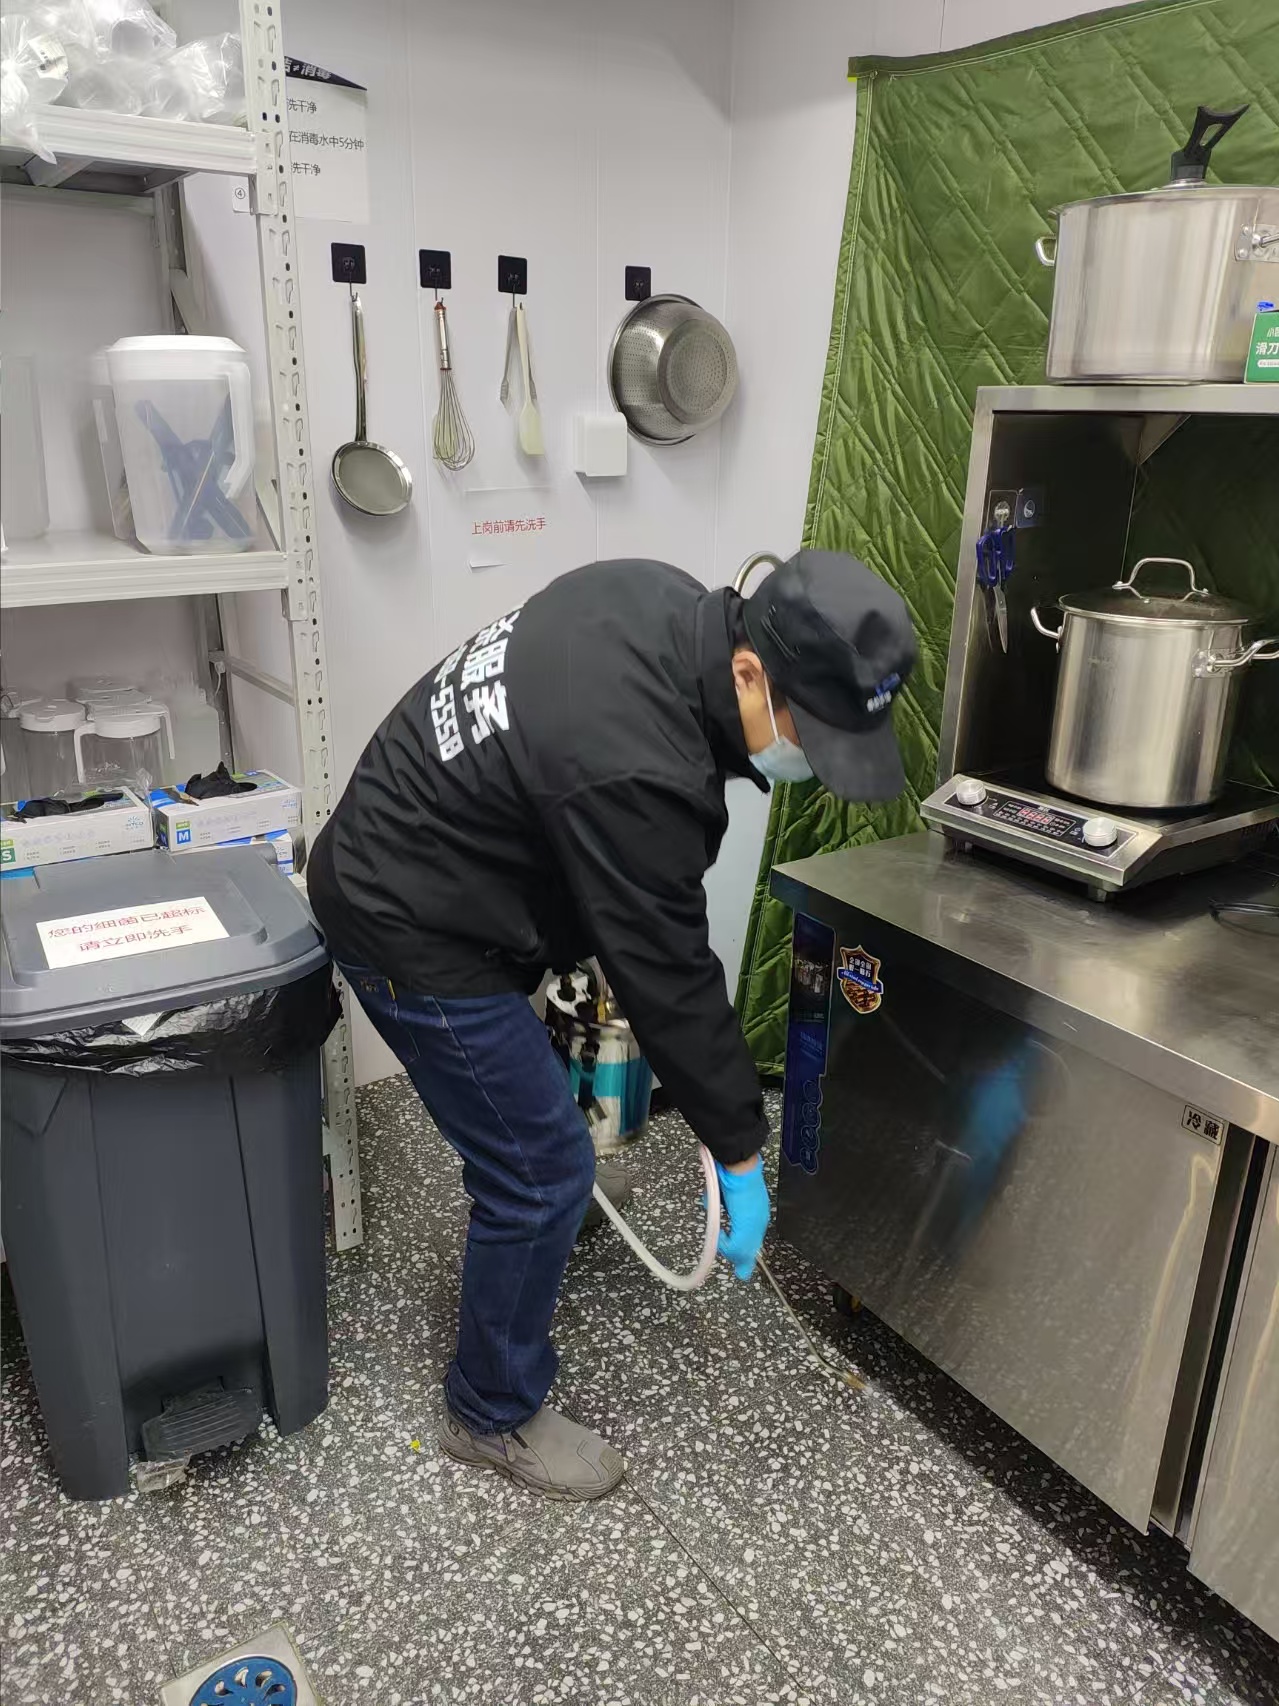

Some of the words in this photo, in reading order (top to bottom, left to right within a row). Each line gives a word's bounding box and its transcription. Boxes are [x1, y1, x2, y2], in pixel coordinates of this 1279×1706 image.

[289, 131, 364, 150] 在消毒水中5分钟
[471, 517, 546, 535] 上岗前请先洗手
[178, 831, 190, 842] M
[2, 850, 12, 861] S
[48, 906, 206, 938] 您的细菌已超标
[79, 924, 193, 952] 请立即洗手
[1187, 1110, 1219, 1140] 冷藏
